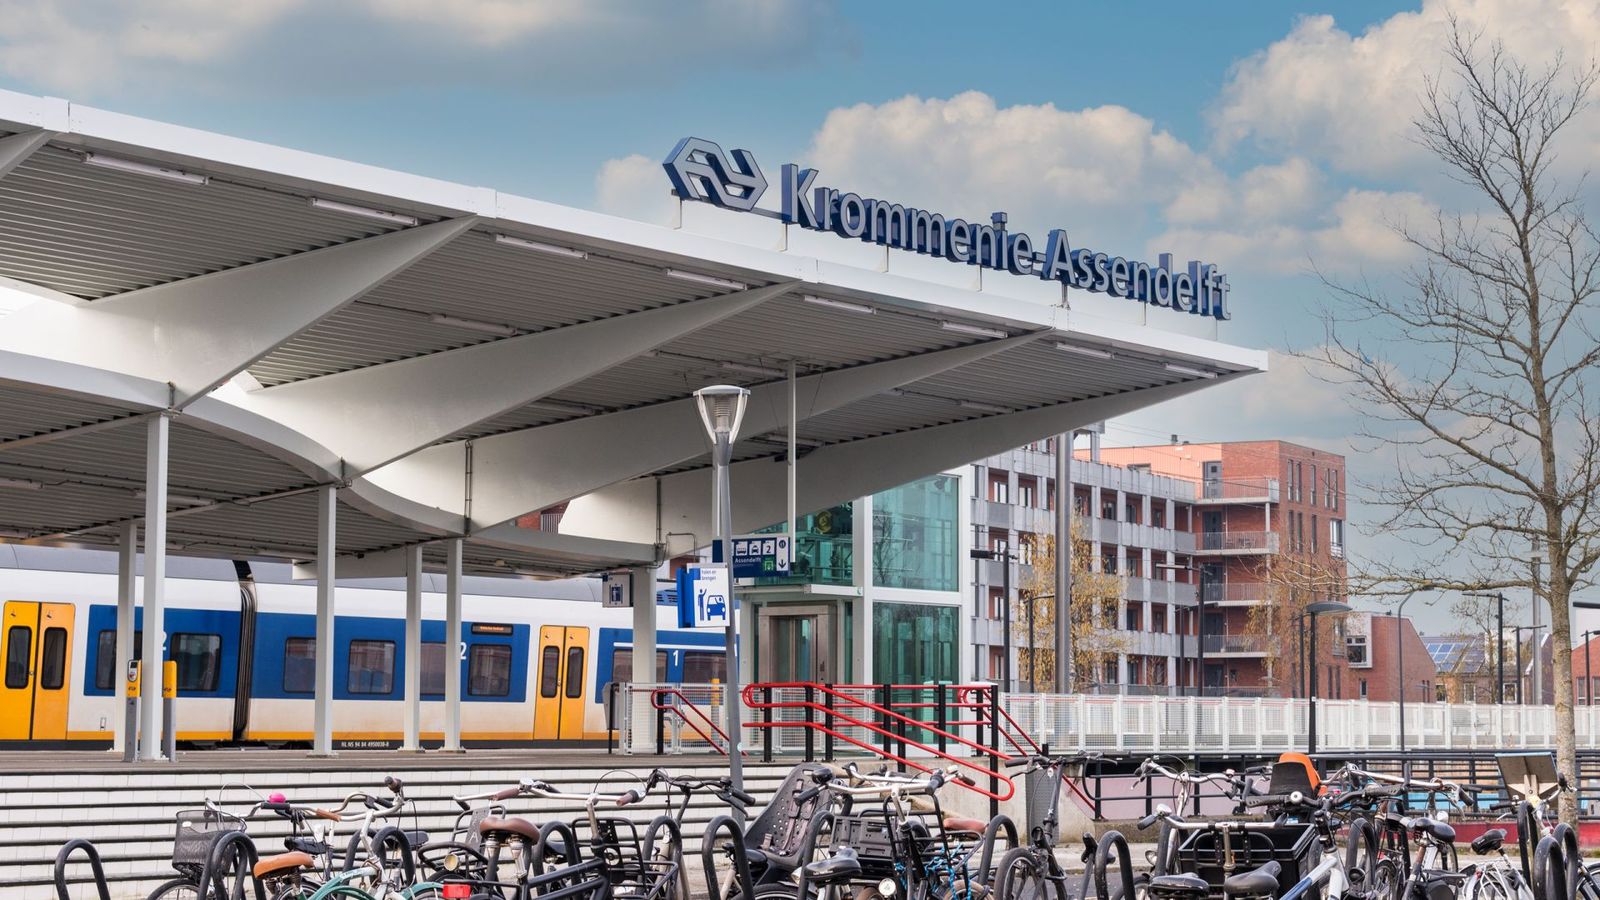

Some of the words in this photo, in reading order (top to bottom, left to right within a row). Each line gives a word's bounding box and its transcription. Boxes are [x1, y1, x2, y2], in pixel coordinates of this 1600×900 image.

[781, 163, 1231, 320] Krommenie-Assendelft
[460, 641, 467, 660] 2
[673, 649, 679, 667] 1
